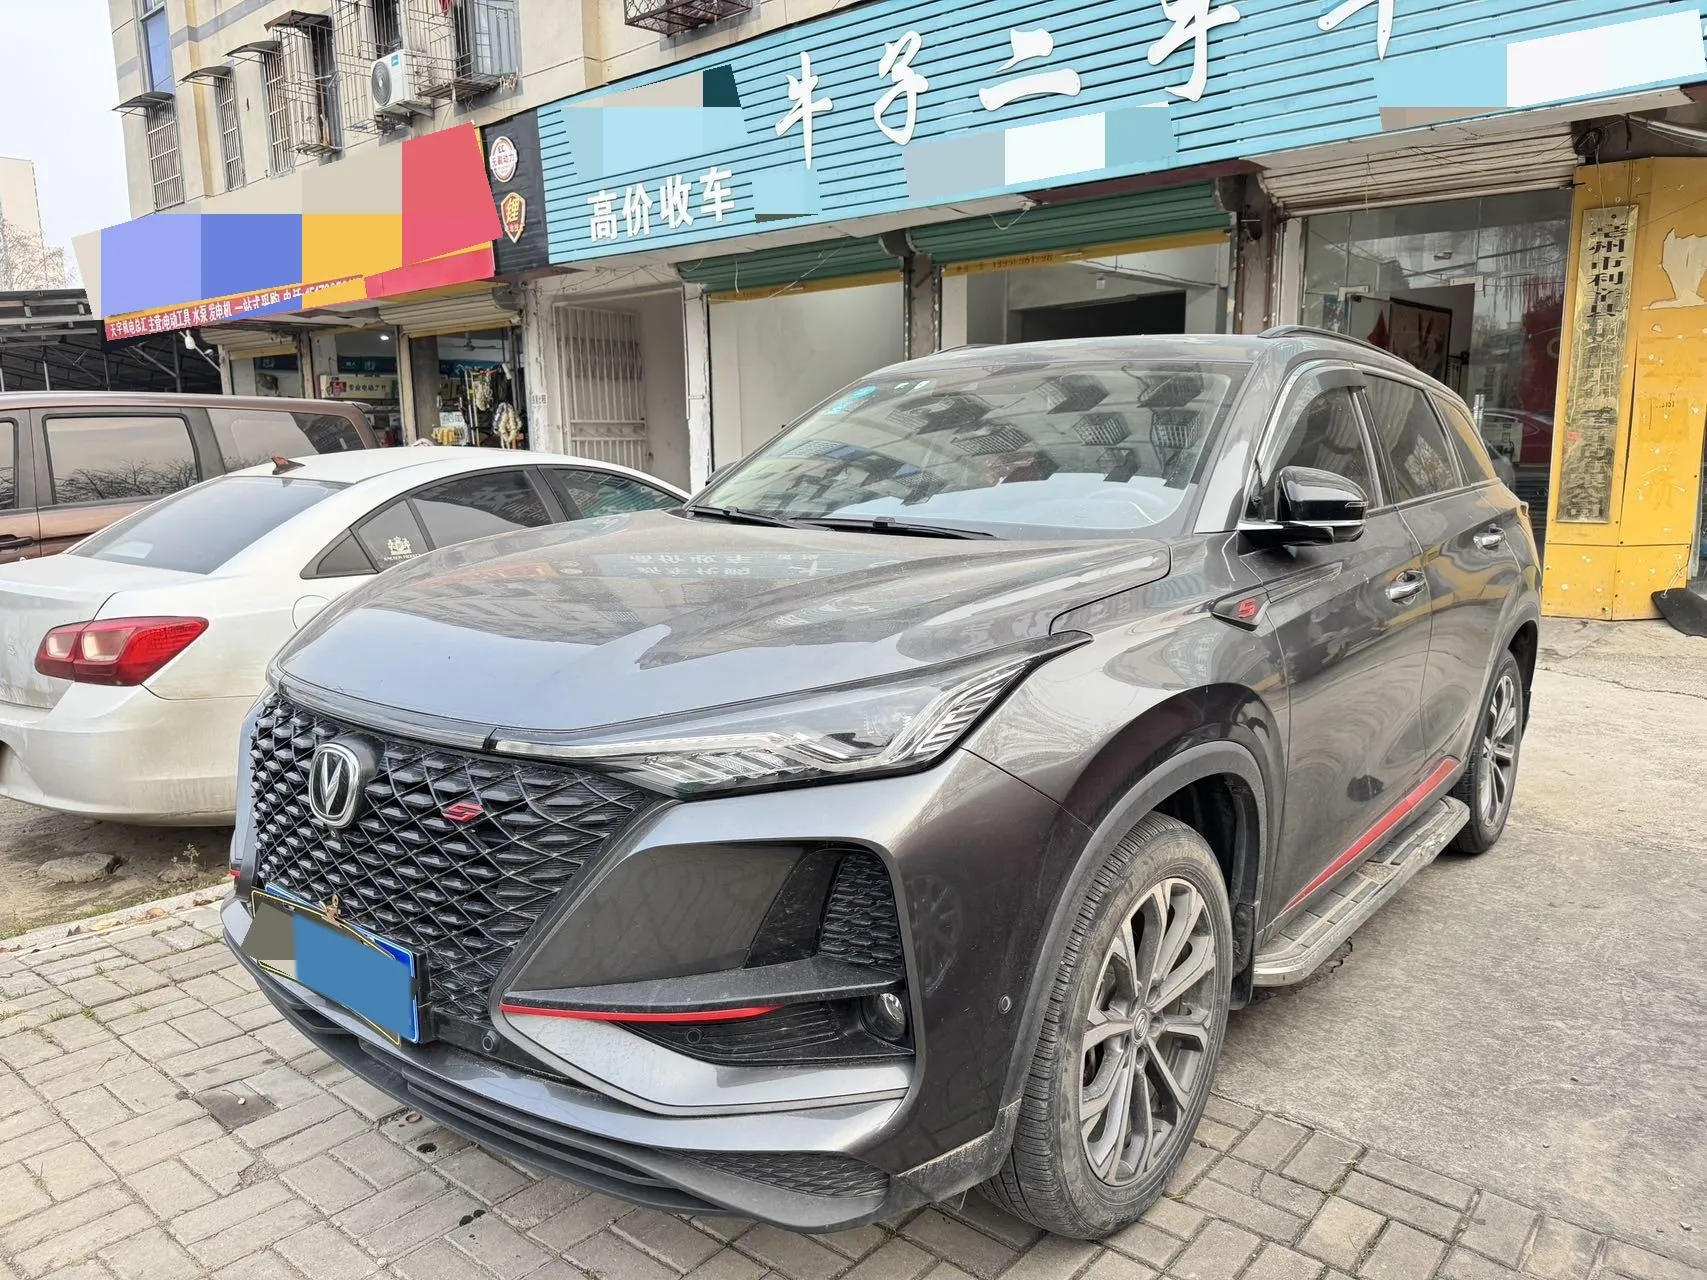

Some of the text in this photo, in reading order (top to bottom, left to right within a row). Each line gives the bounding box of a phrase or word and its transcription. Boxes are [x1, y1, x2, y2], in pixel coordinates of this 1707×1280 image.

[587, 167, 735, 242] 高价收车
[192, 304, 208, 325] 水泵
[209, 300, 233, 322] 发电机
